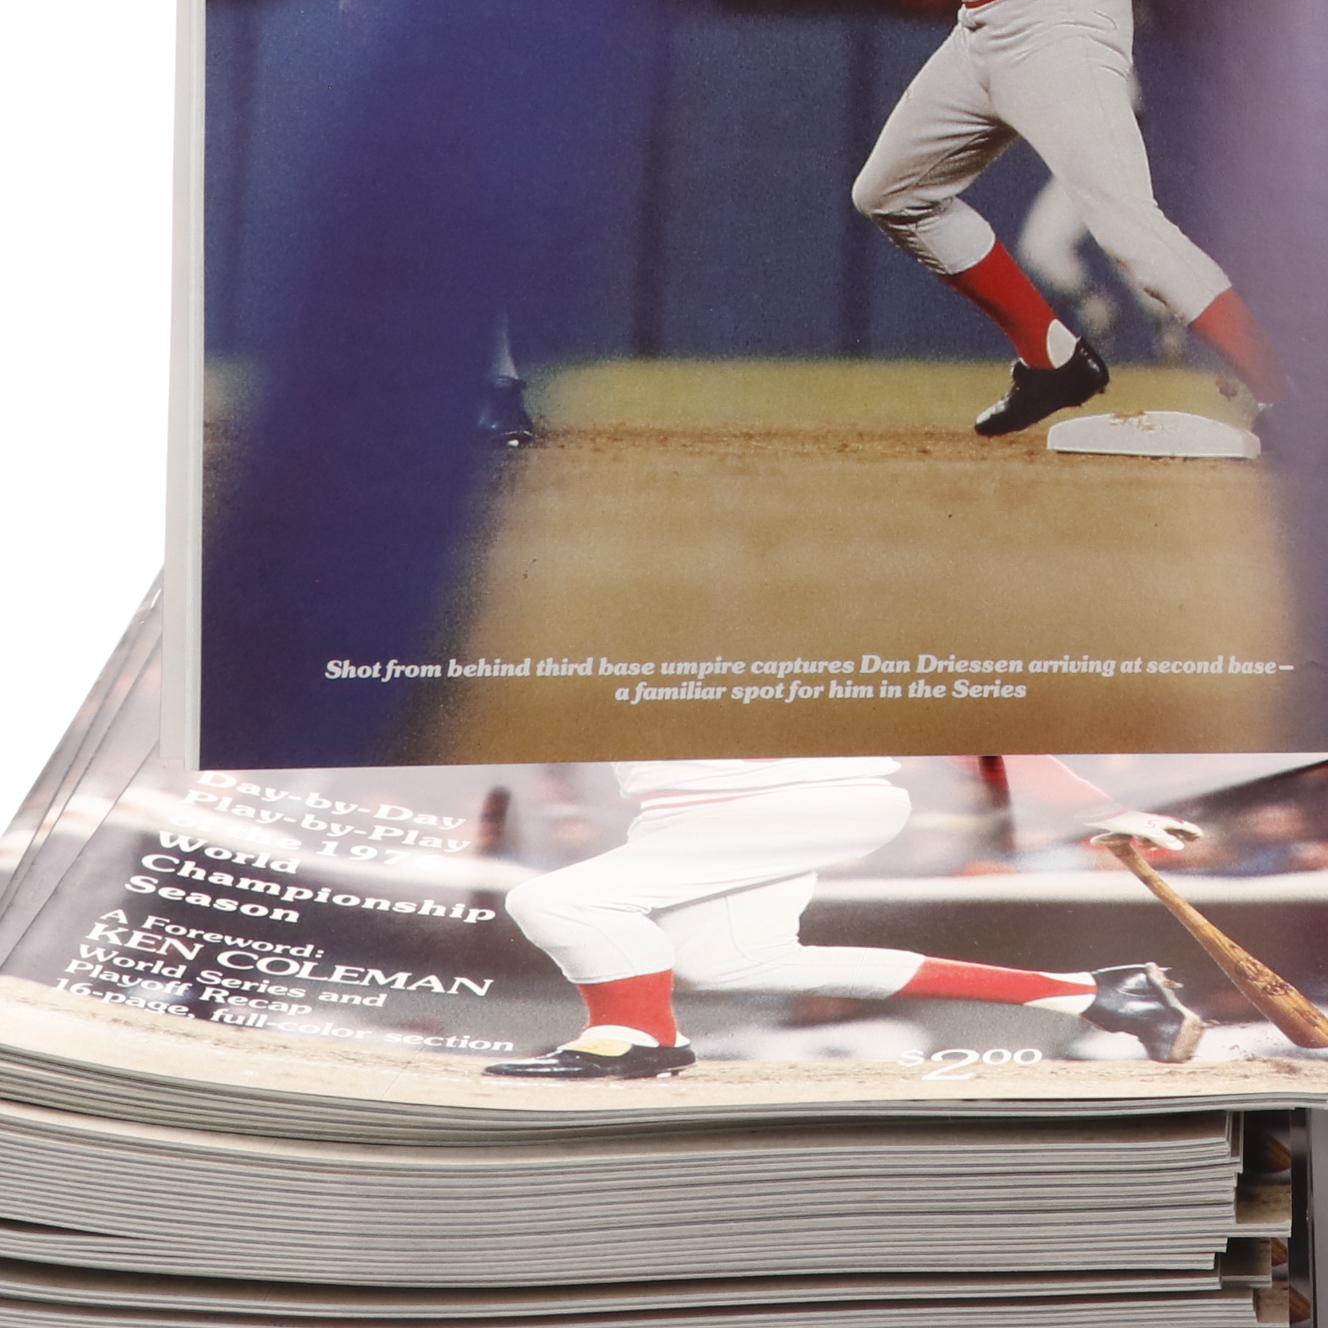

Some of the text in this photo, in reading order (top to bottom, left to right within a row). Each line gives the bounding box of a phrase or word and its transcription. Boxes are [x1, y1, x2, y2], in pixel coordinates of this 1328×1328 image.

[325, 659, 381, 679] Shot
[381, 659, 441, 682] from
[447, 658, 531, 678] behind
[536, 657, 593, 676] third
[599, 656, 655, 676] base
[660, 657, 745, 679] umpire
[751, 657, 854, 679] captures
[860, 655, 910, 674] Dan
[917, 654, 1023, 673] Driessen
[1028, 655, 1116, 678] arriving
[1120, 658, 1142, 674] at
[1146, 655, 1224, 674] second
[615, 679, 1027, 704] a familiar spot for him in the Series
[179, 789, 471, 853] Play-by-Play
[197, 771, 466, 830] Day-by-Day
[159, 830, 301, 874] World
[124, 875, 300, 923] Season
[141, 854, 496, 924] Championship
[85, 921, 495, 997] KEN COLEMAN
[99, 908, 325, 959] A Foreword:
[63, 959, 313, 1016] Playoff Recap
[78, 943, 388, 1008] World Series and
[50, 977, 515, 1052] 16-page, full-color section
